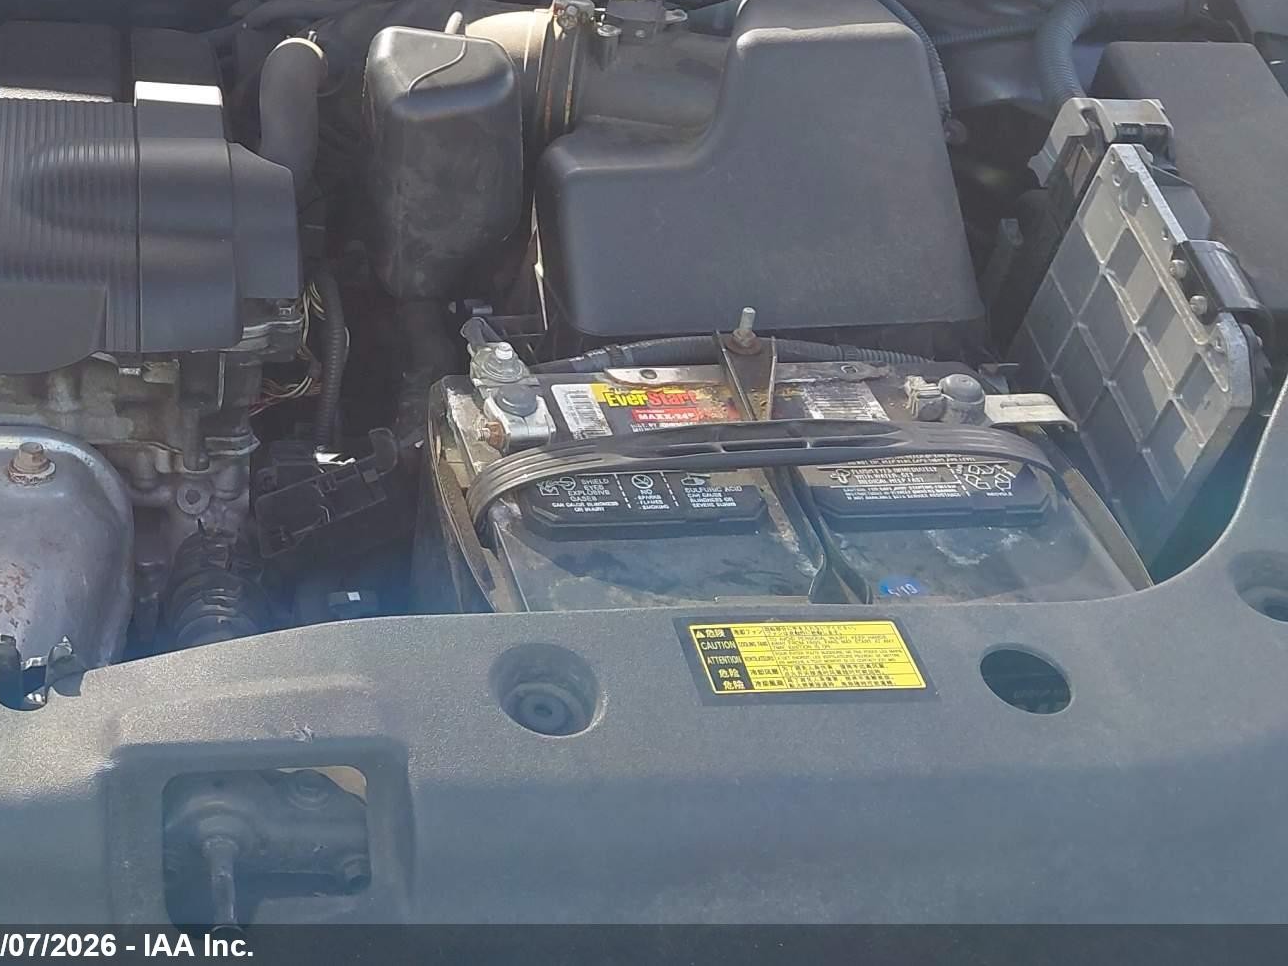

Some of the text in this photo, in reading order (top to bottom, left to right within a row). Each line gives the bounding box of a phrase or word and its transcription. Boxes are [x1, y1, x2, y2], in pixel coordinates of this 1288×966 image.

[606, 390, 697, 408] EverStart
[700, 641, 737, 650] CAUTION
[707, 655, 743, 665] ATTENTION
